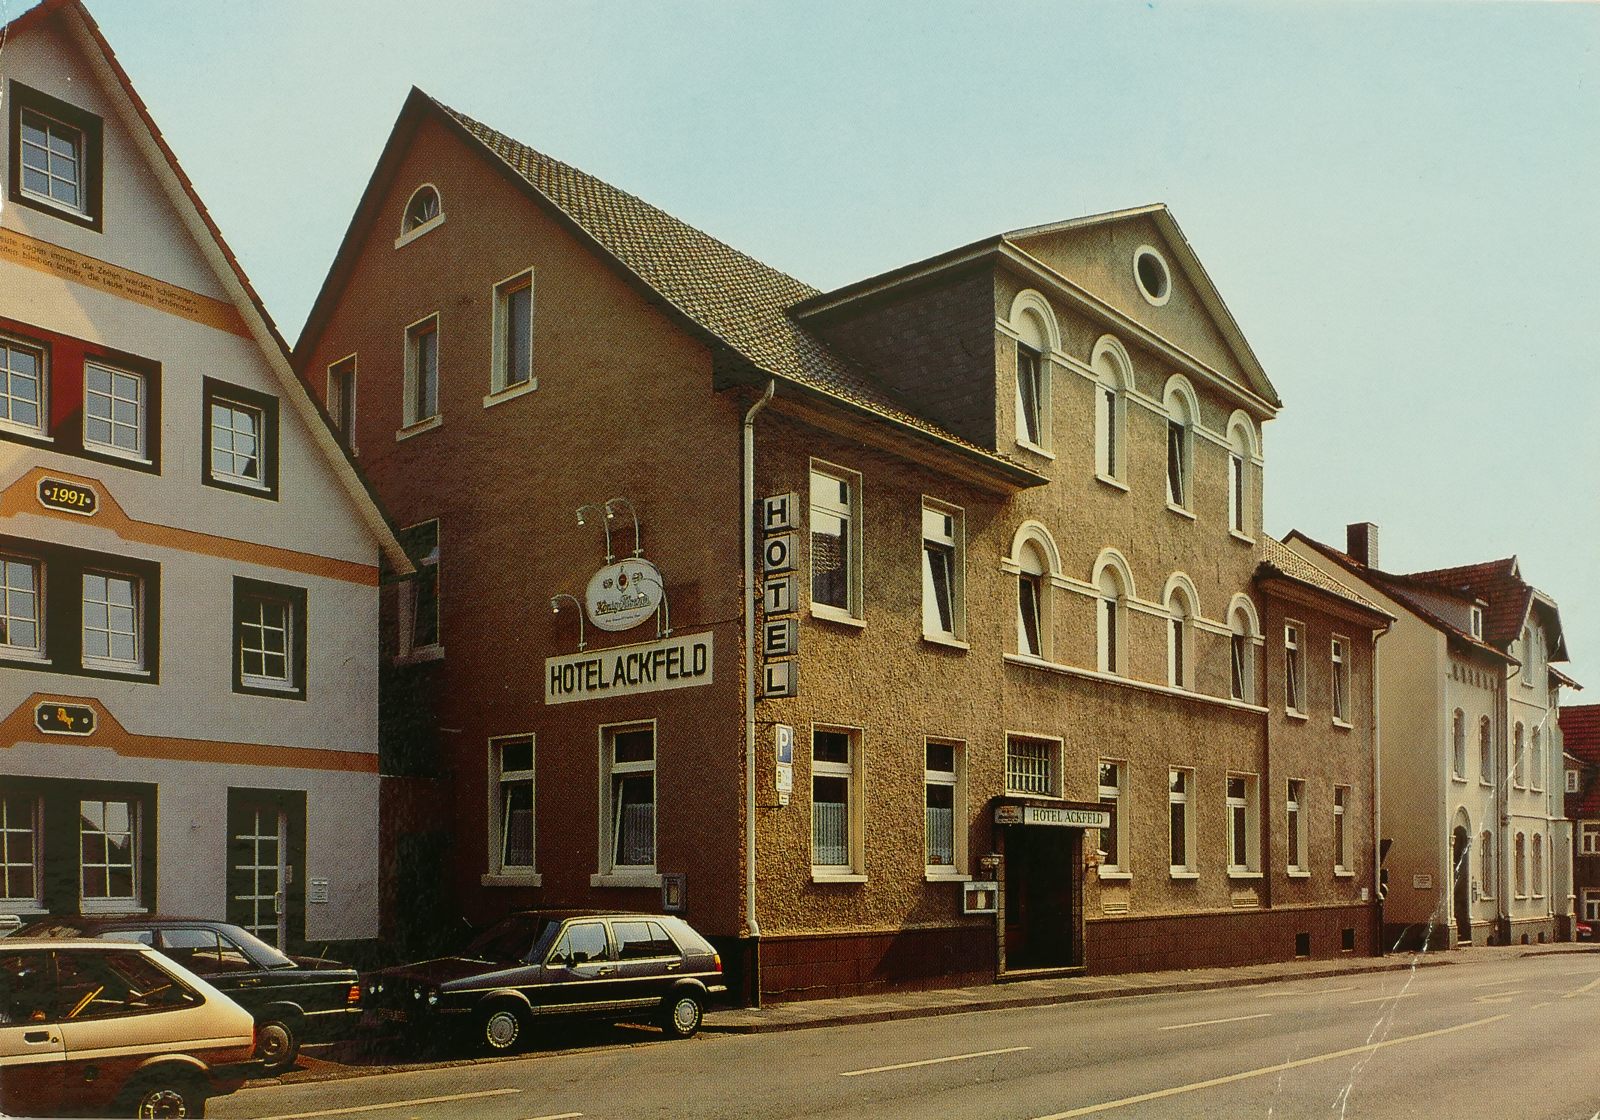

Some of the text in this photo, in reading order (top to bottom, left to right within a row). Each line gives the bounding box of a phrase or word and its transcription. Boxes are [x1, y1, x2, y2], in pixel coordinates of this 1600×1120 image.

[50, 487, 85, 507] 1991
[765, 498, 787, 692] HOTEL
[550, 643, 708, 696] HOTEL ACKFELD
[779, 728, 789, 757] P
[1032, 809, 1063, 823] HOTEL
[1065, 811, 1104, 825] ACKFELD
